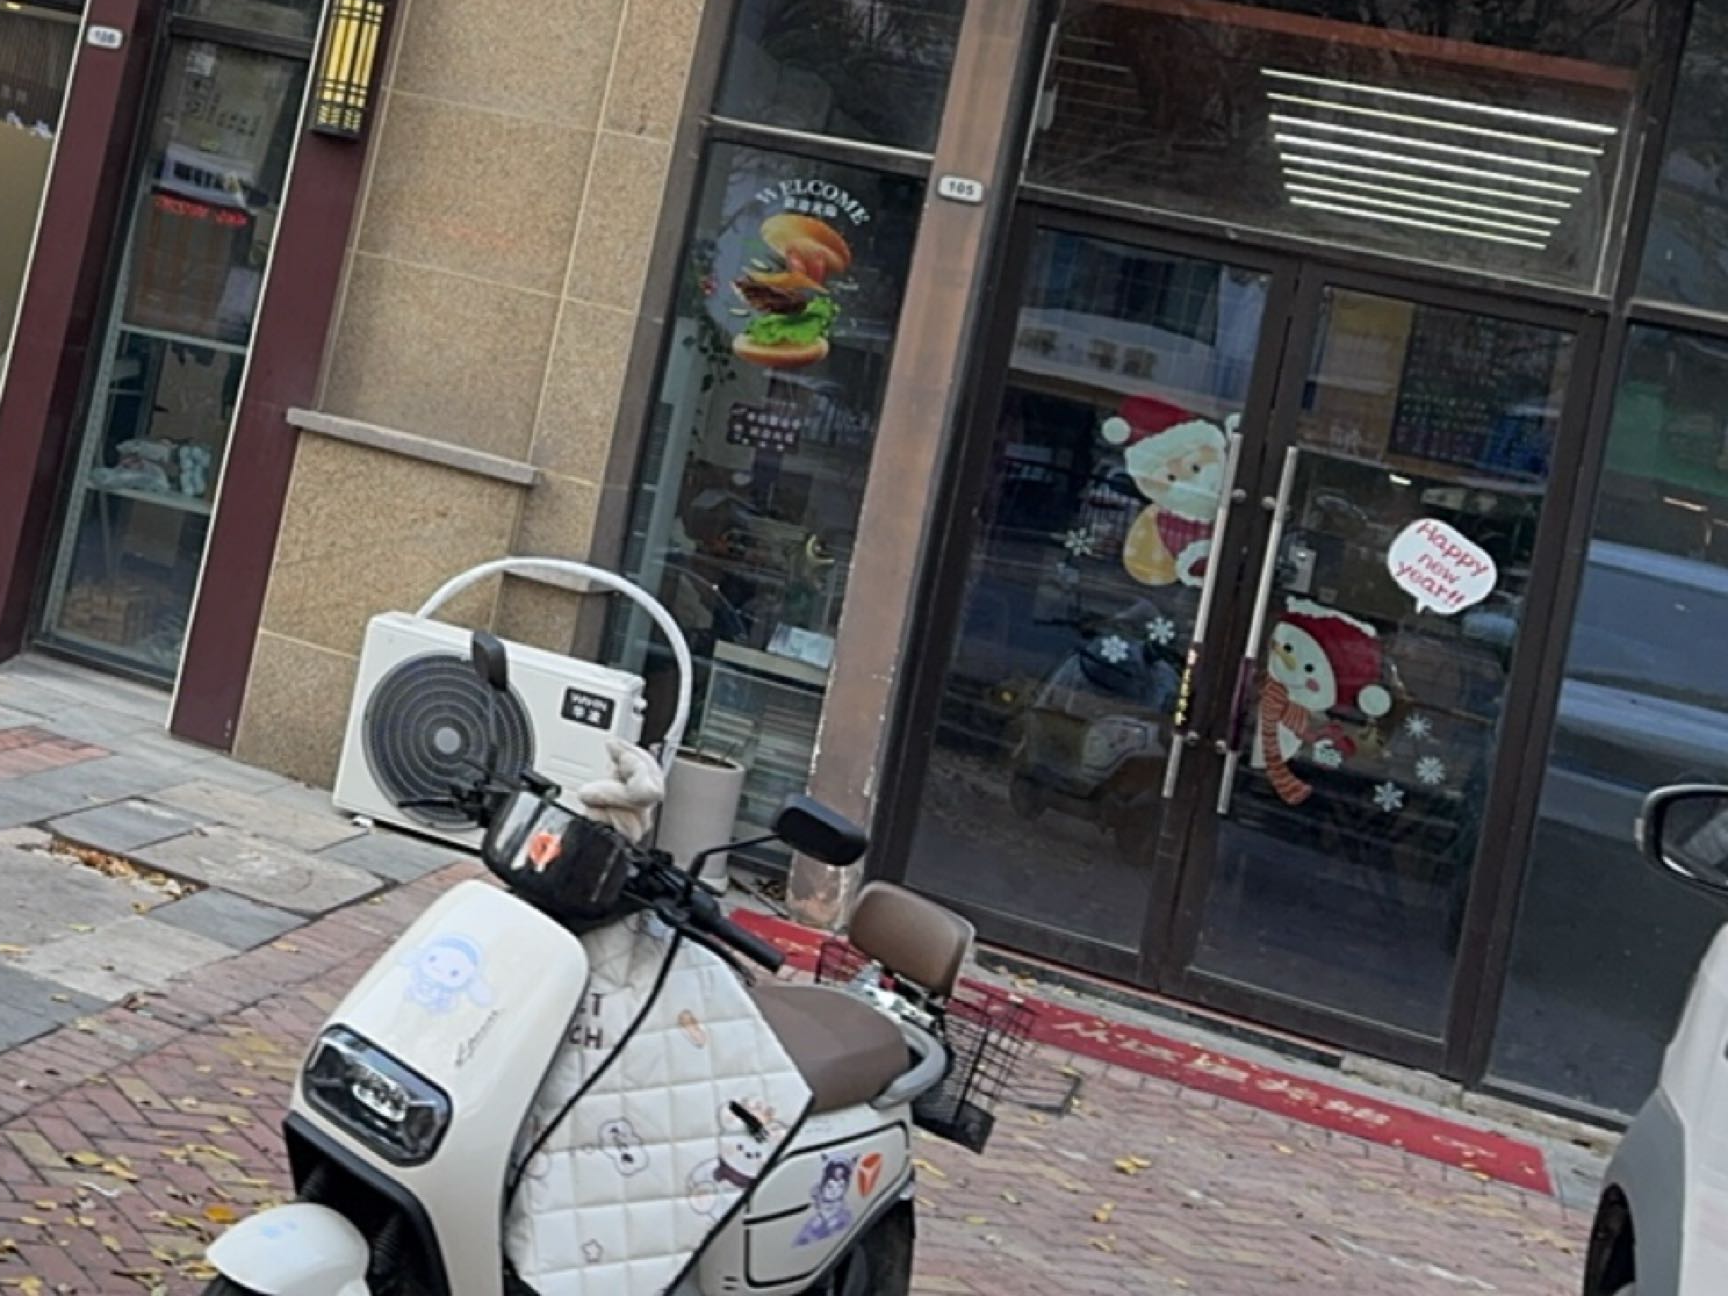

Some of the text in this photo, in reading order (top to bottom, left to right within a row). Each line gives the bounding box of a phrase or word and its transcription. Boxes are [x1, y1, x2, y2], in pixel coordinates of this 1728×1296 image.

[755, 179, 872, 226] WELCOME
[1416, 521, 1489, 577] Happy
[1418, 554, 1461, 583] new
